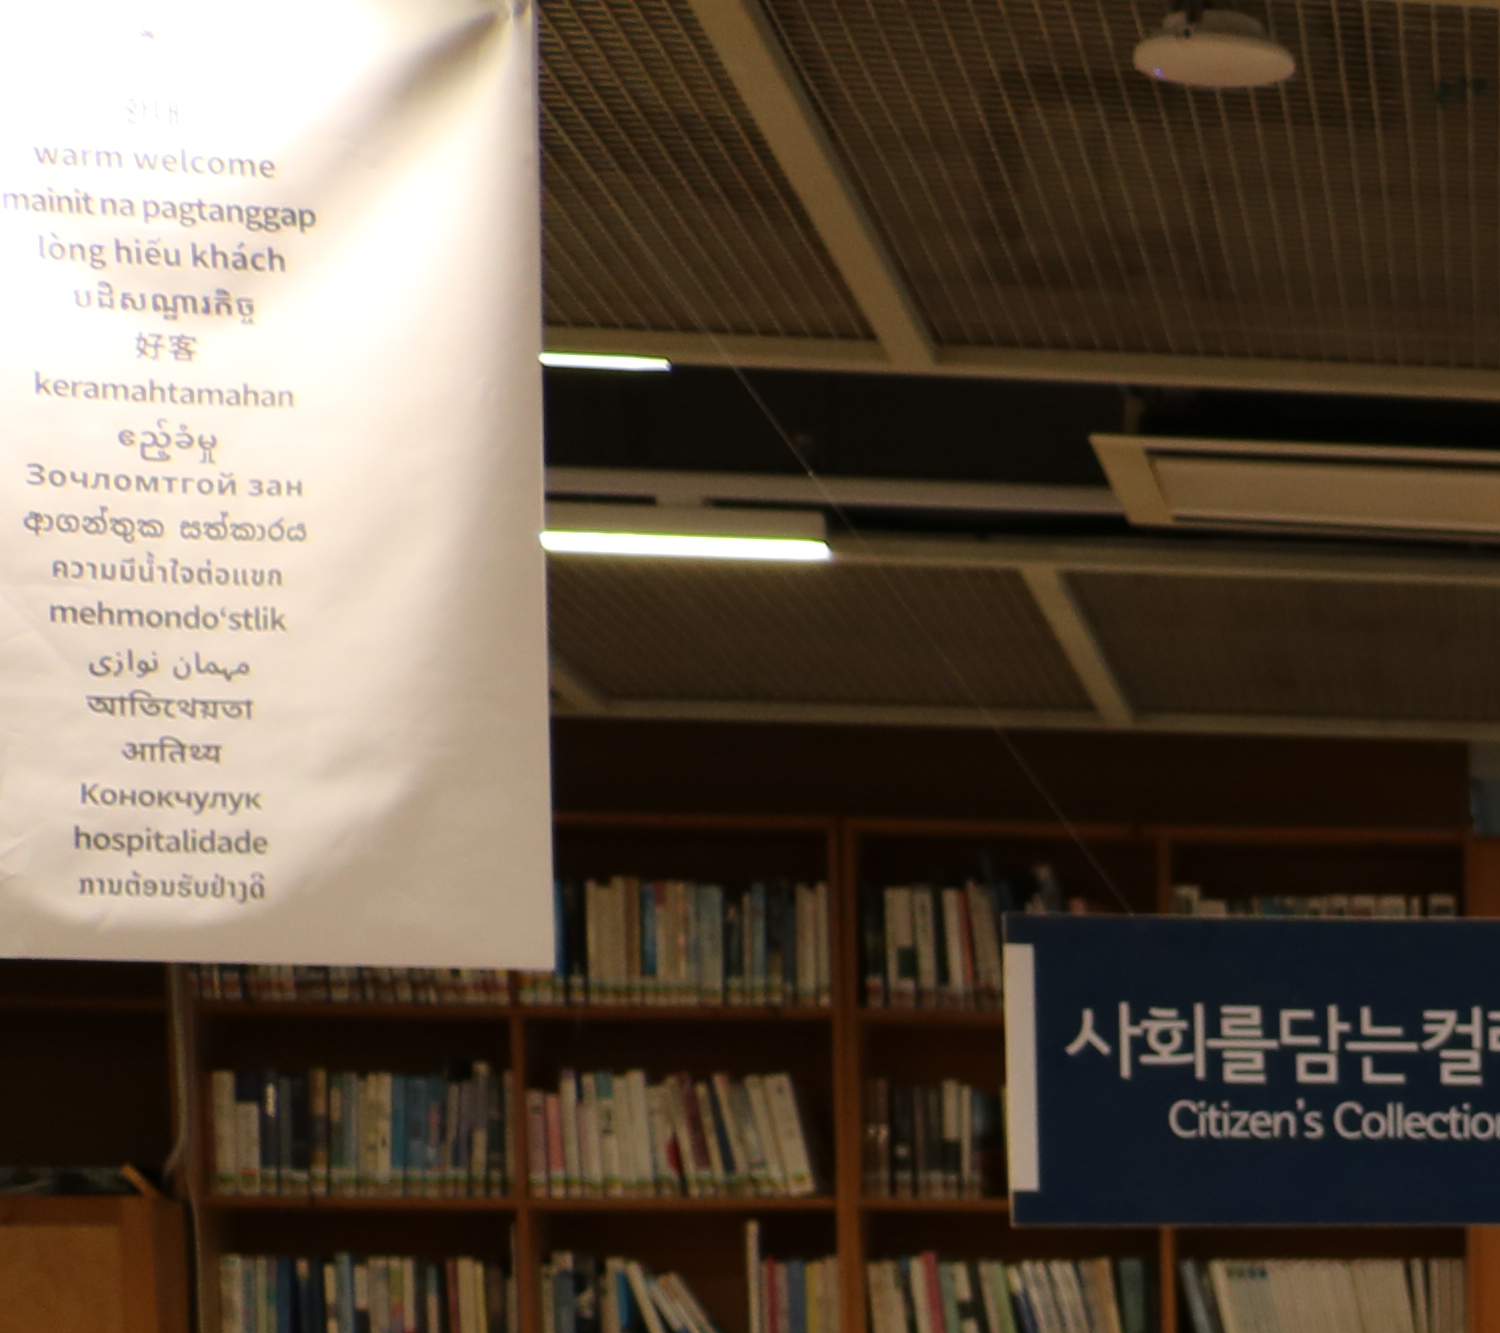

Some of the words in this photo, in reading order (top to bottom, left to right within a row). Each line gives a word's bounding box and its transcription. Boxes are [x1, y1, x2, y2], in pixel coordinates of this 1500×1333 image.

[34, 146, 123, 170] warm
[133, 149, 276, 179] welcome
[1, 187, 96, 216] mainit
[100, 195, 136, 217] na
[142, 198, 317, 234] pagtanggap
[38, 231, 107, 270] lòng
[190, 241, 288, 273] khách
[134, 332, 198, 362] 好客
[34, 370, 295, 408] keramahtamahan
[25, 462, 238, 497] Зочломтгой
[246, 477, 304, 498] зан
[79, 782, 263, 815] Конокчулук
[73, 825, 270, 858] hospitalidade
[1167, 1097, 1325, 1140] Citizen's
